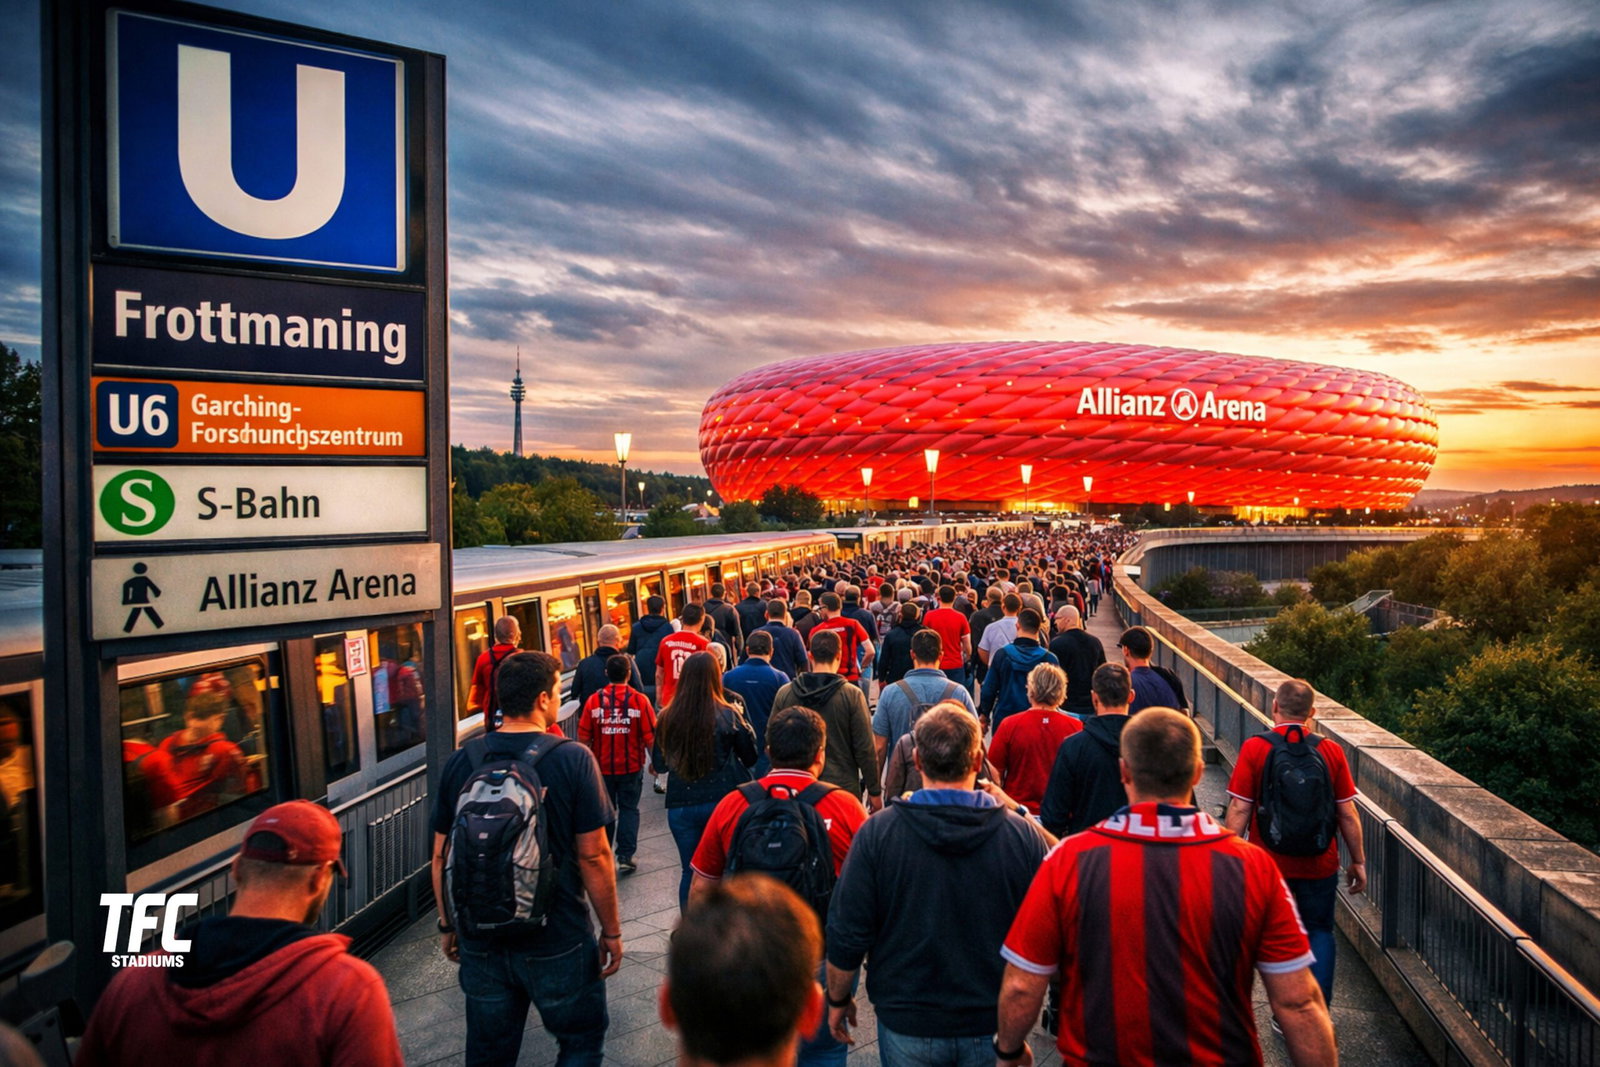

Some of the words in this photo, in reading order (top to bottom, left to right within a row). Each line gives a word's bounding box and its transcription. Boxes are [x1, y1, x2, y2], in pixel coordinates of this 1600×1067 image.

[178, 44, 347, 240] U
[115, 290, 407, 365] Frottmaning
[109, 393, 169, 436] U6
[191, 393, 301, 423] Garching-
[1077, 387, 1166, 417] Allianz
[1200, 391, 1266, 422] Arena
[120, 478, 157, 527] S
[198, 486, 320, 520] S-Bahn
[199, 573, 318, 612] Allianz
[328, 568, 416, 602] Arena
